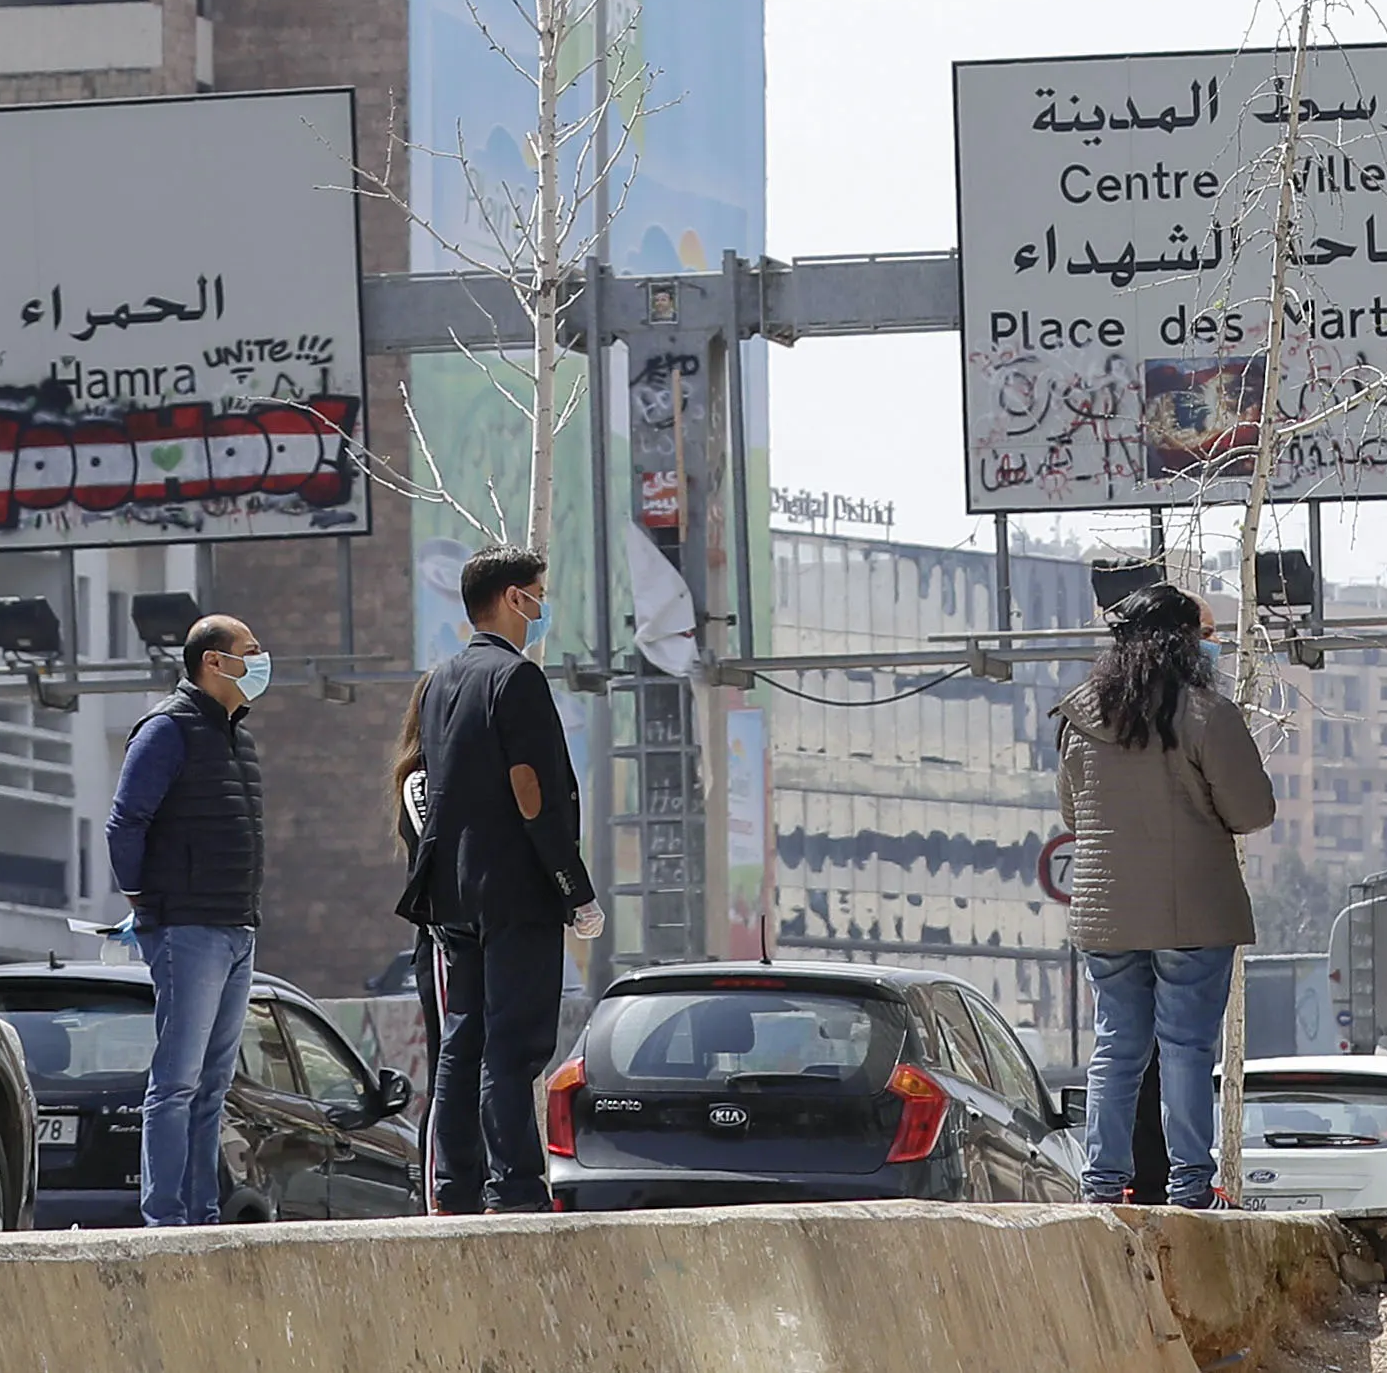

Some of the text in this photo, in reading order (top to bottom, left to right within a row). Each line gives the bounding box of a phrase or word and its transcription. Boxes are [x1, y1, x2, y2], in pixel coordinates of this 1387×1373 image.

[1031, 75, 1220, 146] المدينة
[1059, 161, 1220, 204] Centre
[19, 273, 225, 342] الحمراء
[989, 309, 1126, 351] Place
[1159, 304, 1245, 346] des
[50, 359, 197, 401] Hamra
[833, 494, 896, 526] District
[595, 1098, 642, 1113] picanto
[714, 1109, 742, 1124] KIA
[37, 1119, 63, 1141] 78
